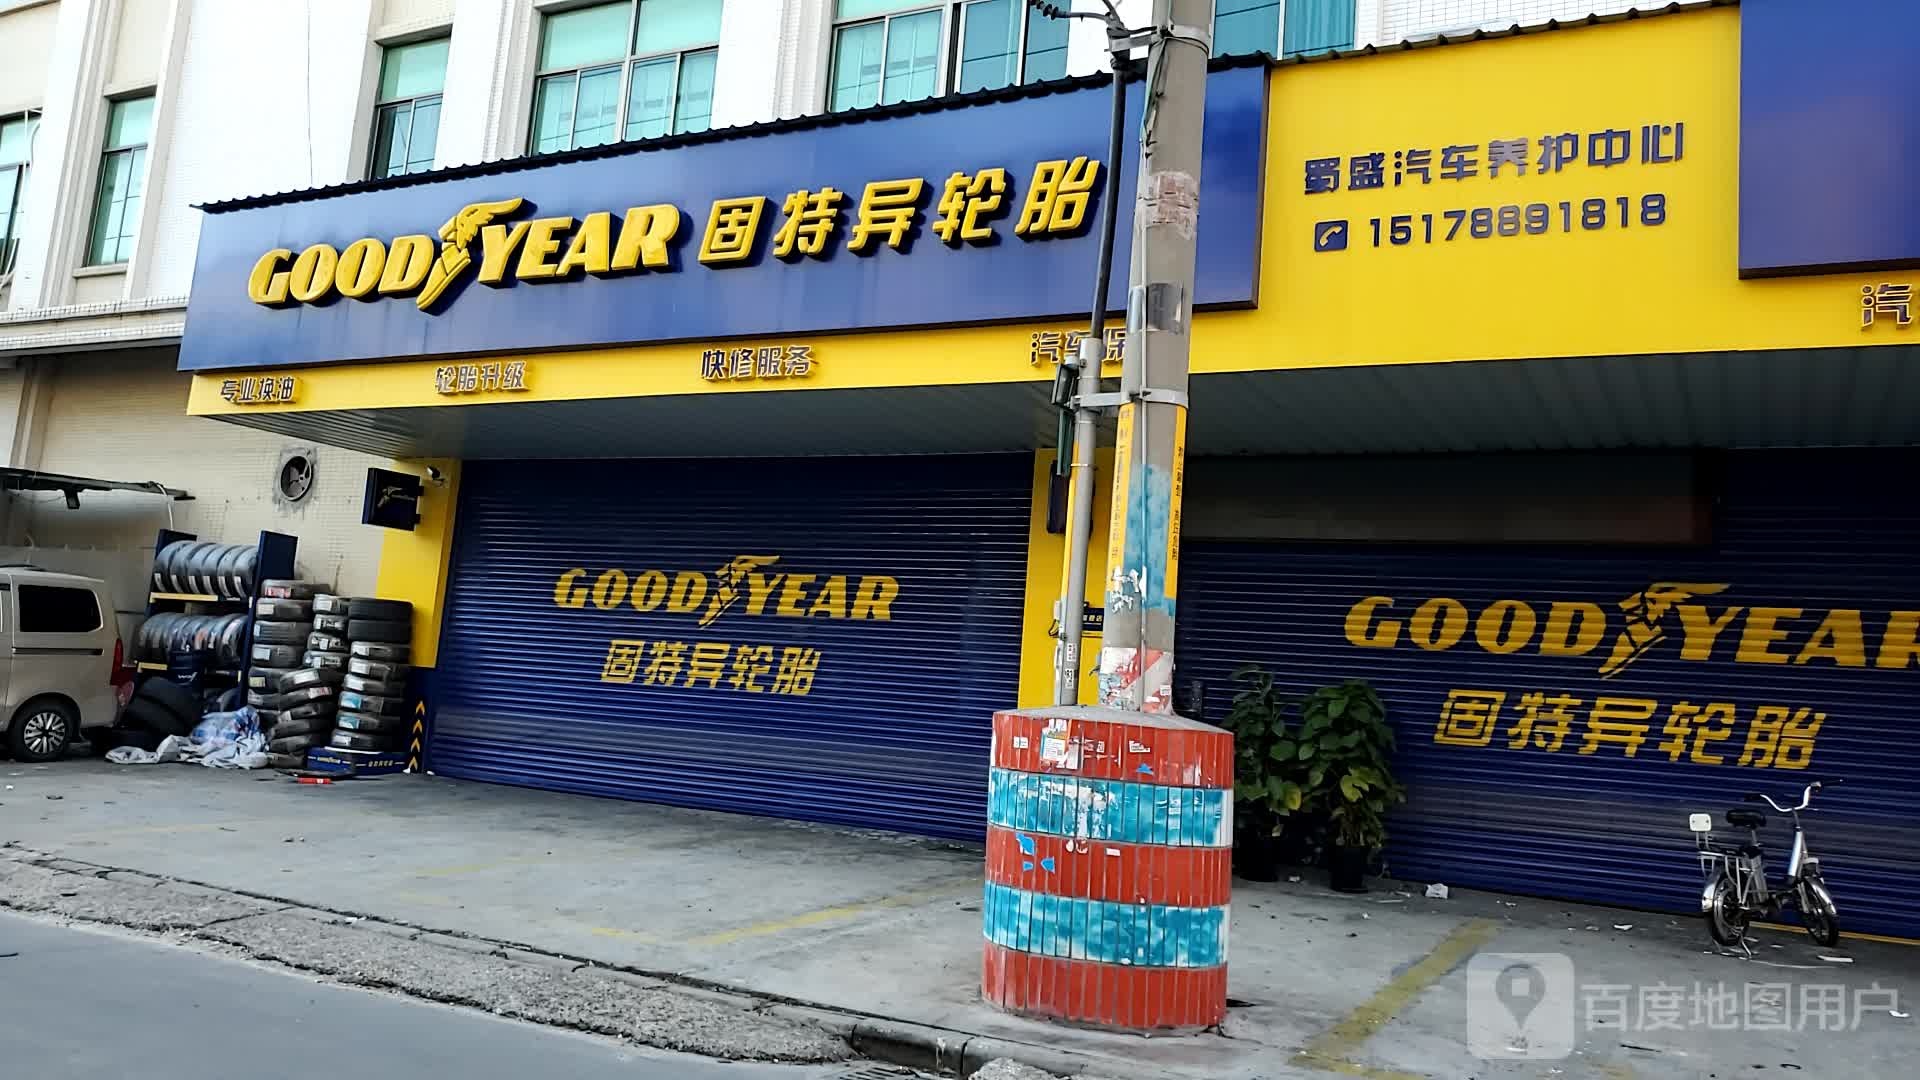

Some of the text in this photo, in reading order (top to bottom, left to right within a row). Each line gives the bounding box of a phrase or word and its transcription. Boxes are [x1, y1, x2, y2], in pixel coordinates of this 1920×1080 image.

[1304, 122, 1684, 195] 蜀盛汽车养护中心
[698, 157, 1101, 264] 固特异轮胎
[1369, 193, 1667, 248] 15178891818
[249, 203, 682, 307] GOODYEAR
[1861, 283, 1913, 326] 汽
[220, 376, 296, 402] 专业换油
[435, 361, 526, 393] 轮胎升级
[701, 345, 812, 379] 快修服务
[553, 556, 901, 625] GOODYEAR
[599, 638, 822, 697] 固特异轮胎
[1433, 688, 1826, 770] 固特异轮胎
